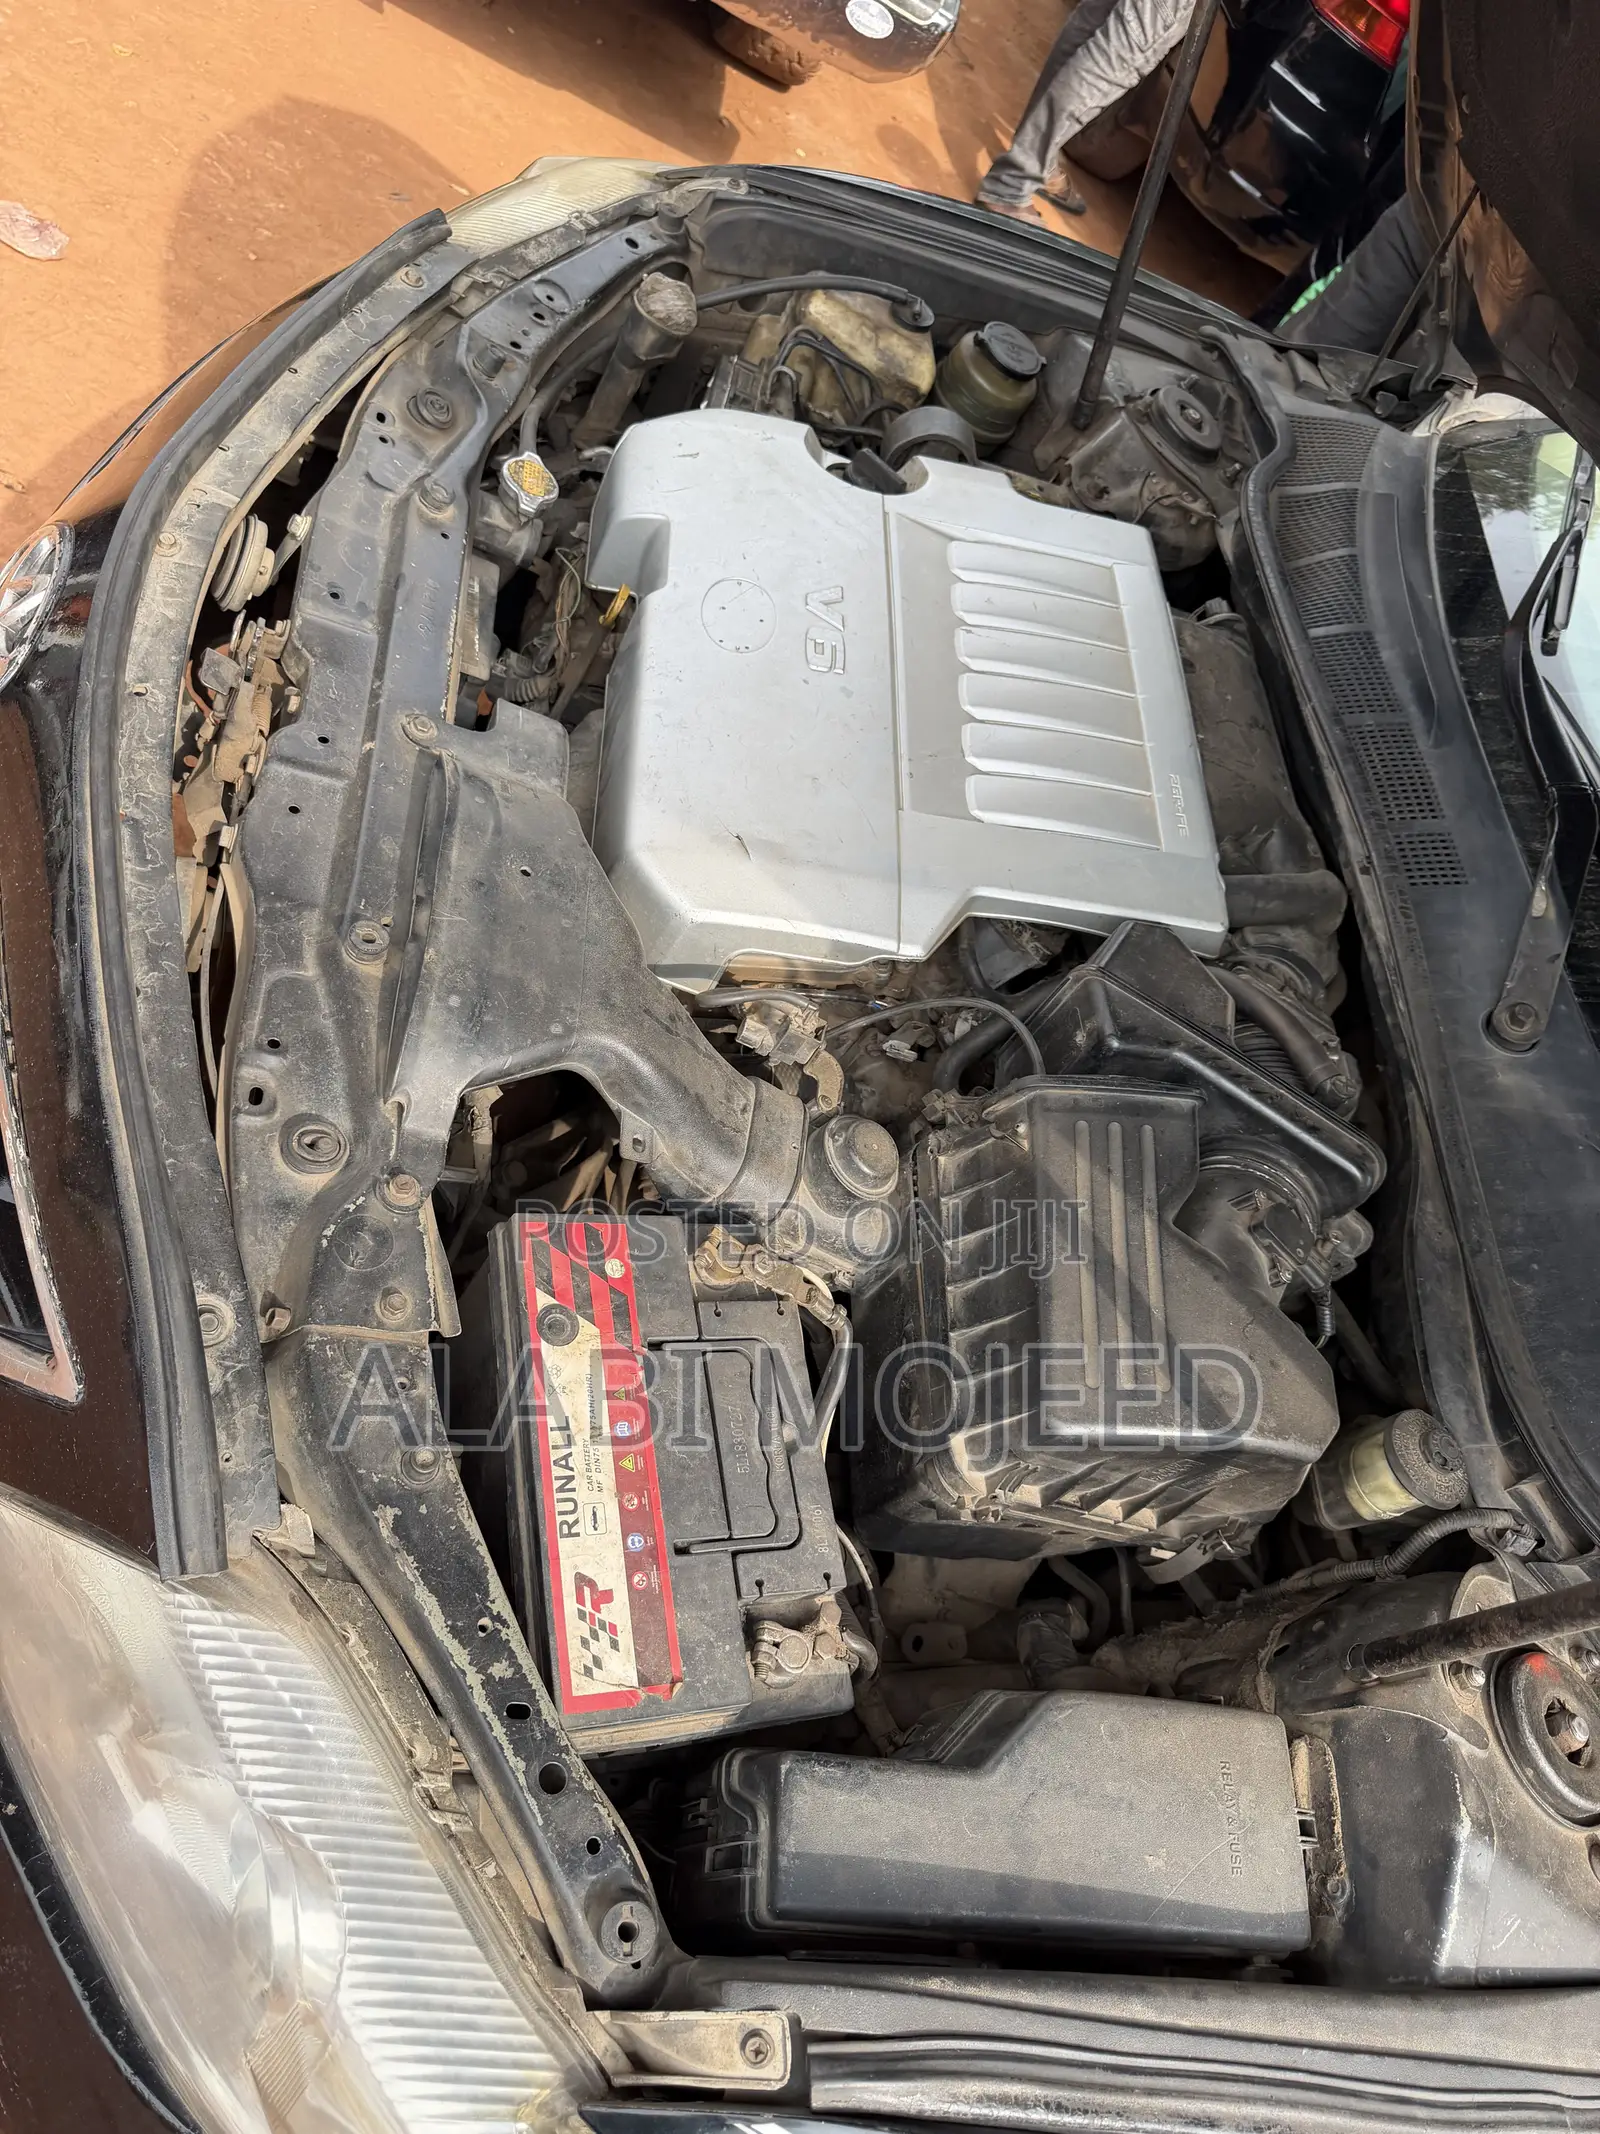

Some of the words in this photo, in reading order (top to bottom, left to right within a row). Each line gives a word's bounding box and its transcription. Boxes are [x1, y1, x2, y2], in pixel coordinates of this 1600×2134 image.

[805, 585, 846, 675] V6
[582, 1438, 593, 1473] BATTERY
[593, 1447, 602, 1474] DIN75
[550, 1415, 581, 1539] RUNALL
[586, 1474, 595, 1492] CAR
[596, 1479, 604, 1493] MF
[1220, 1760, 1238, 1815] RELAY
[1227, 1816, 1238, 1827] &
[1228, 1832, 1243, 1877] FUSE
